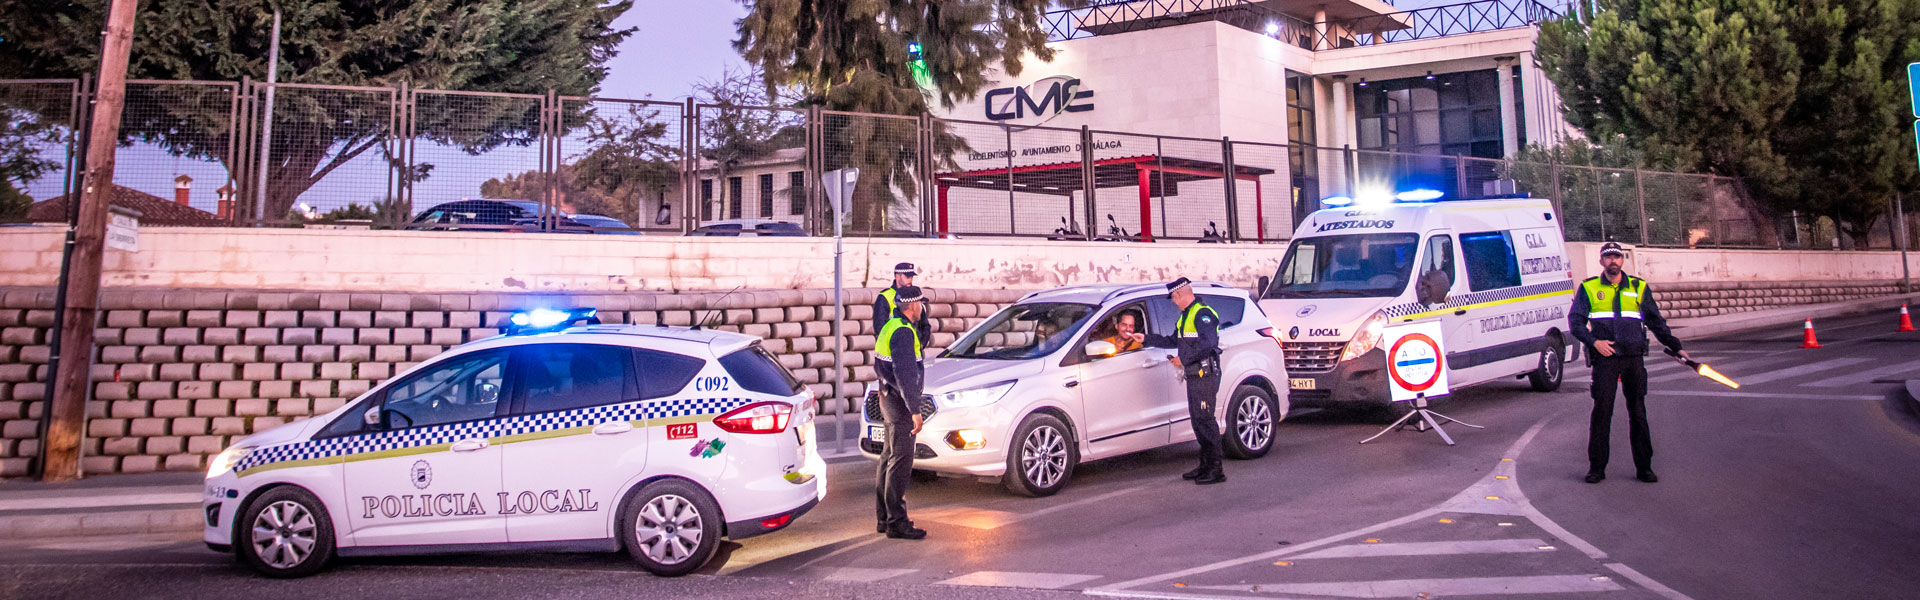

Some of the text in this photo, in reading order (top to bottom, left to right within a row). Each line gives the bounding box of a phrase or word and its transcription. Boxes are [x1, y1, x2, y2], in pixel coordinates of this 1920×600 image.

[985, 79, 1094, 121] CME
[1022, 145, 1071, 156] AYUNTAMIENTO
[1316, 220, 1395, 232] ATESTADOS
[1308, 328, 1341, 337] LOCAL
[704, 376, 729, 391] 092
[675, 424, 694, 435] 112
[362, 488, 599, 519] POLICIA LOCAL
